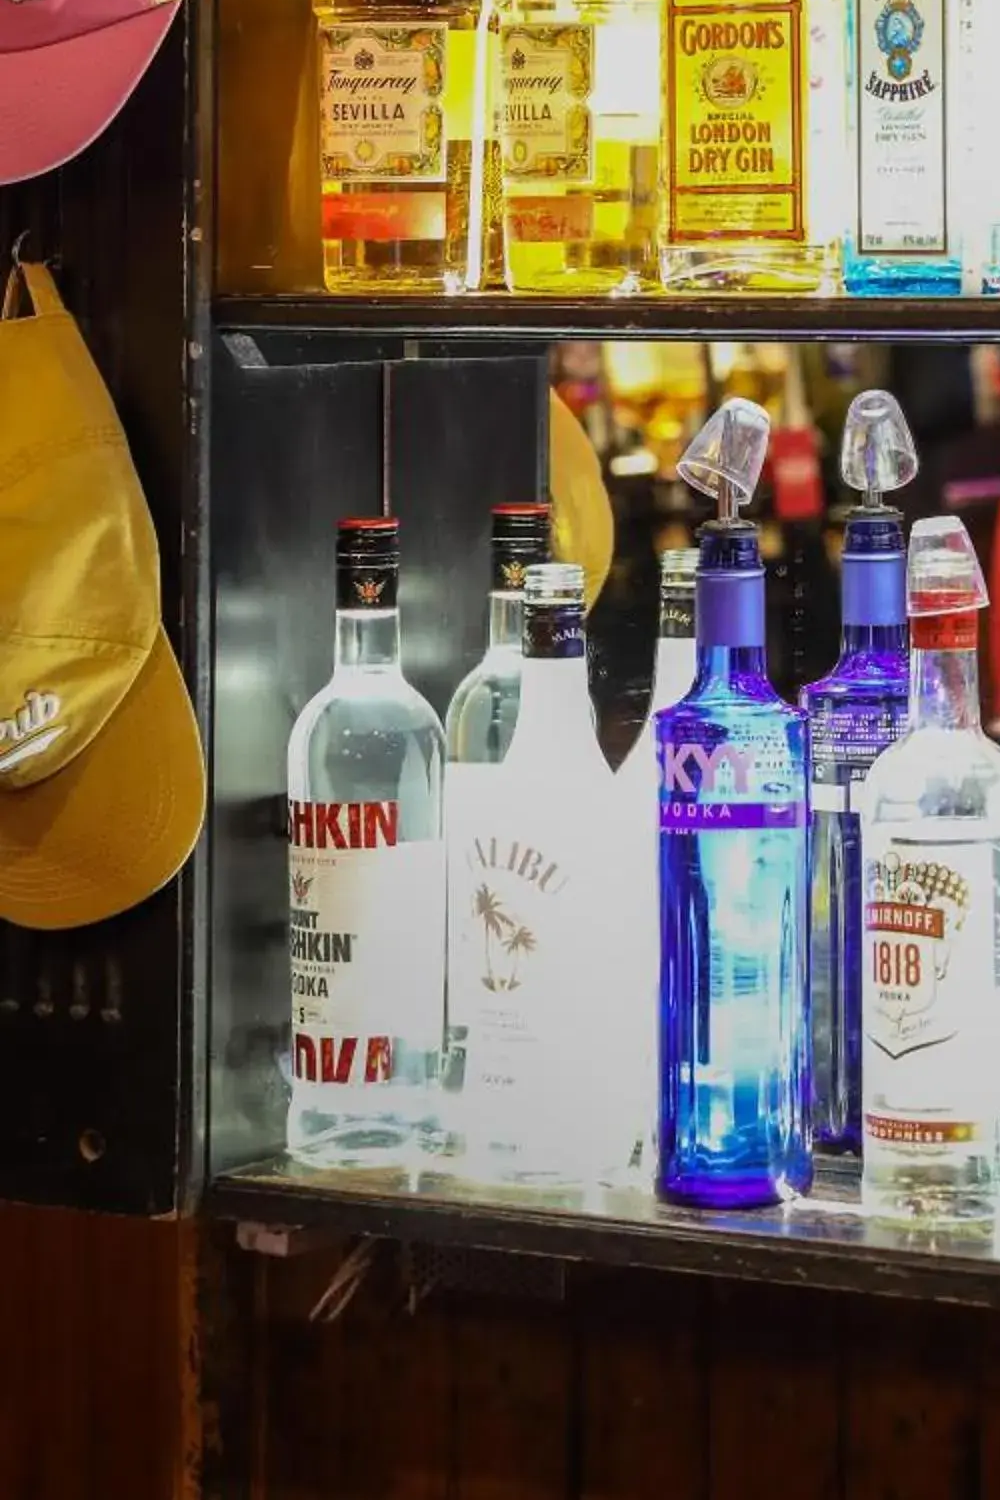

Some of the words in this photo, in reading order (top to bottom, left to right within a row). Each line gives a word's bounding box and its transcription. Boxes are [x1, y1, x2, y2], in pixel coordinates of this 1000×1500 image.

[327, 69, 417, 95] Tanqueray
[864, 69, 936, 102] SAPPHIRE
[332, 103, 405, 121] SEVILLA
[690, 121, 772, 144] LONDON
[688, 147, 731, 173] DRY
[736, 147, 774, 173] GIN
[288, 801, 398, 850] HKIN
[873, 941, 921, 988] 1818
